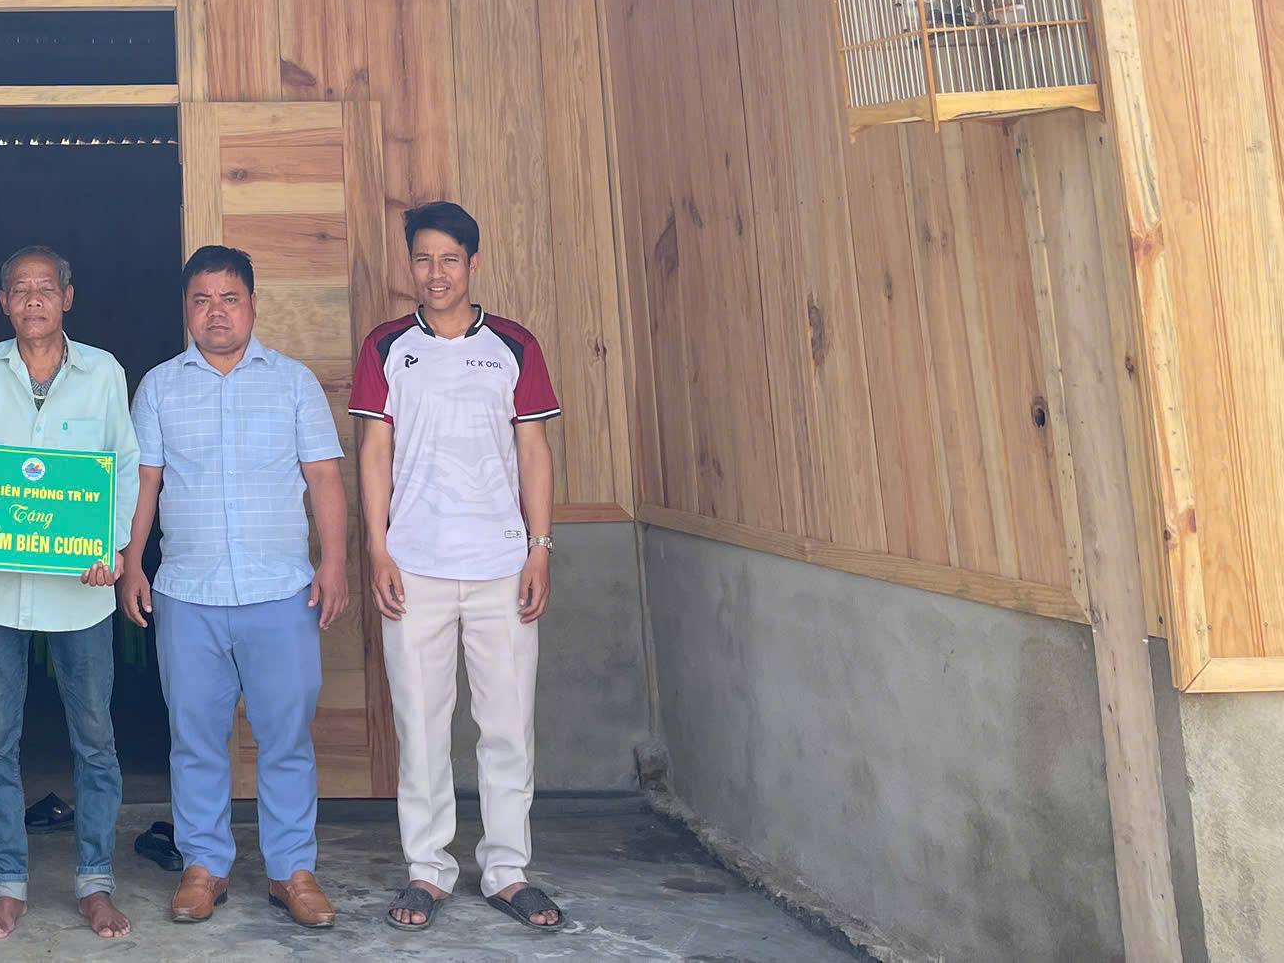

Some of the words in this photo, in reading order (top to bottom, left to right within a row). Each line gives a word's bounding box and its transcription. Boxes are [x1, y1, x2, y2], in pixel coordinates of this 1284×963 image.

[23, 486, 64, 501] PHÒNG
[16, 532, 51, 554] BIÊN
[54, 536, 104, 557] CƯƠNG
